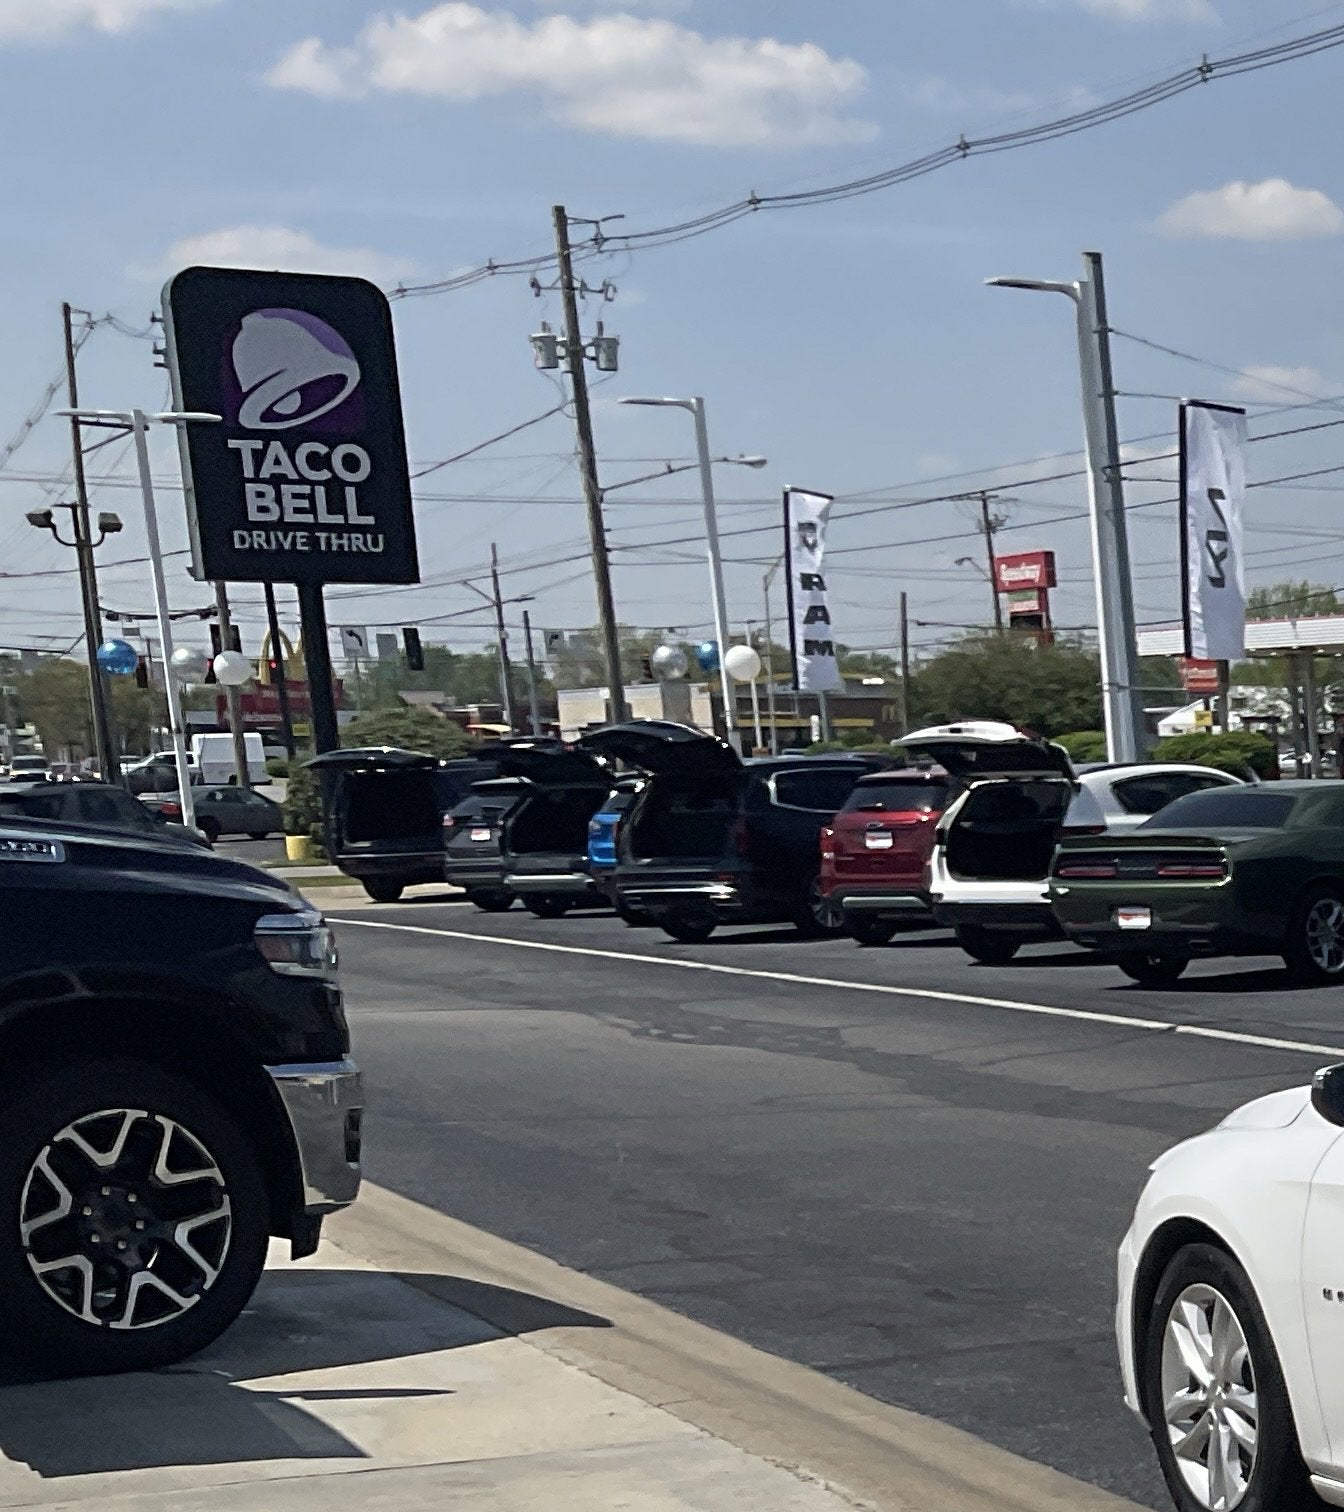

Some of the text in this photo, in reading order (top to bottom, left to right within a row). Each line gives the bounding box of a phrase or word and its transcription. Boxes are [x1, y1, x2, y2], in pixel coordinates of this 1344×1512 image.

[227, 438, 372, 483] TACO
[244, 482, 376, 525] BELL
[232, 529, 385, 553] DRIVE THRU
[800, 572, 836, 657] RAM
